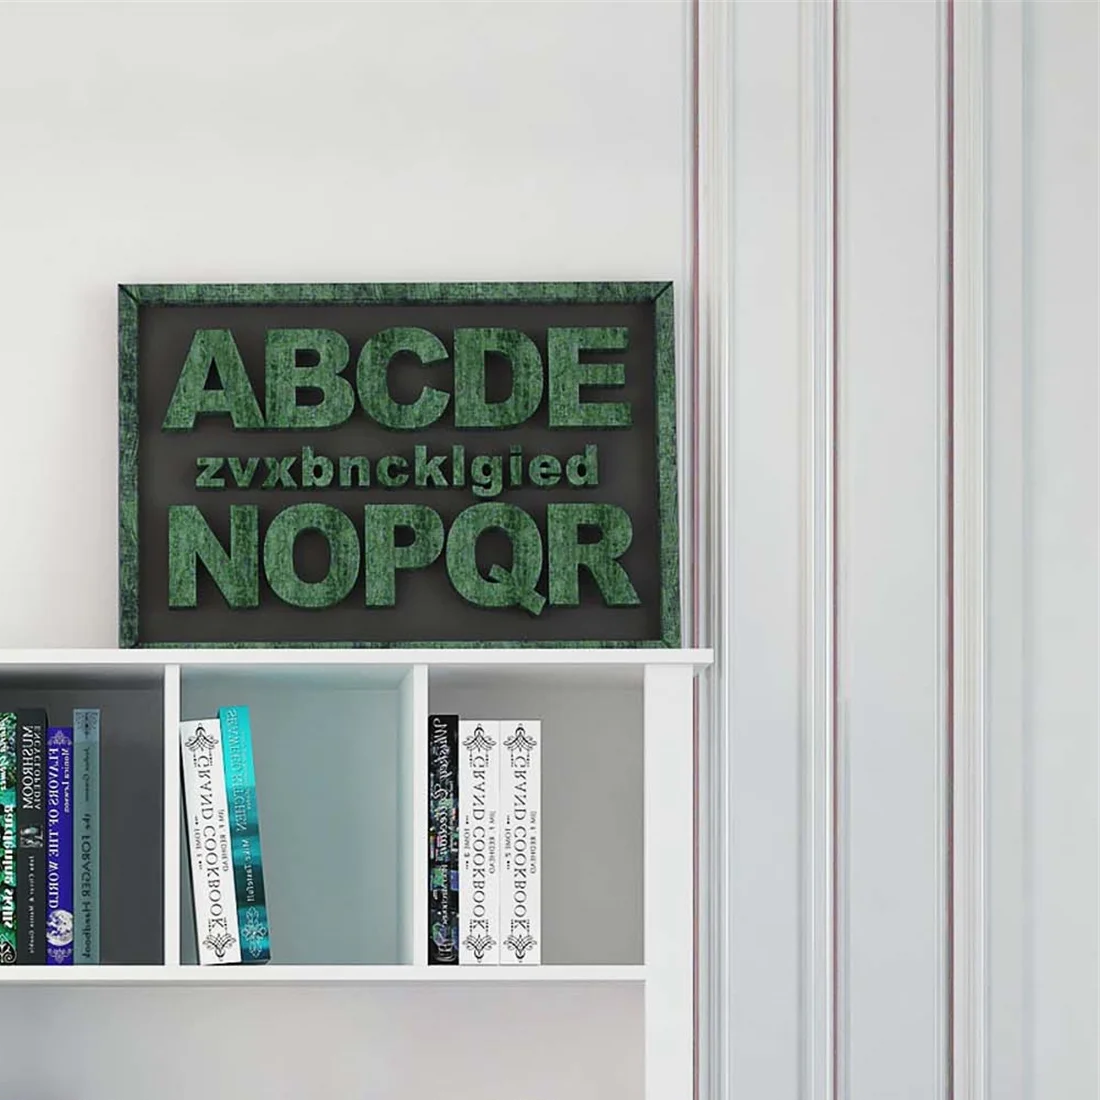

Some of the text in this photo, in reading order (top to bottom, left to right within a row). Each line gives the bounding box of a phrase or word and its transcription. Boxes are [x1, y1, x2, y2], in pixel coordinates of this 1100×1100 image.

[161, 327, 634, 431] ABCDE
[195, 445, 600, 498] zvxbncklgied
[167, 502, 642, 615] NOPQR
